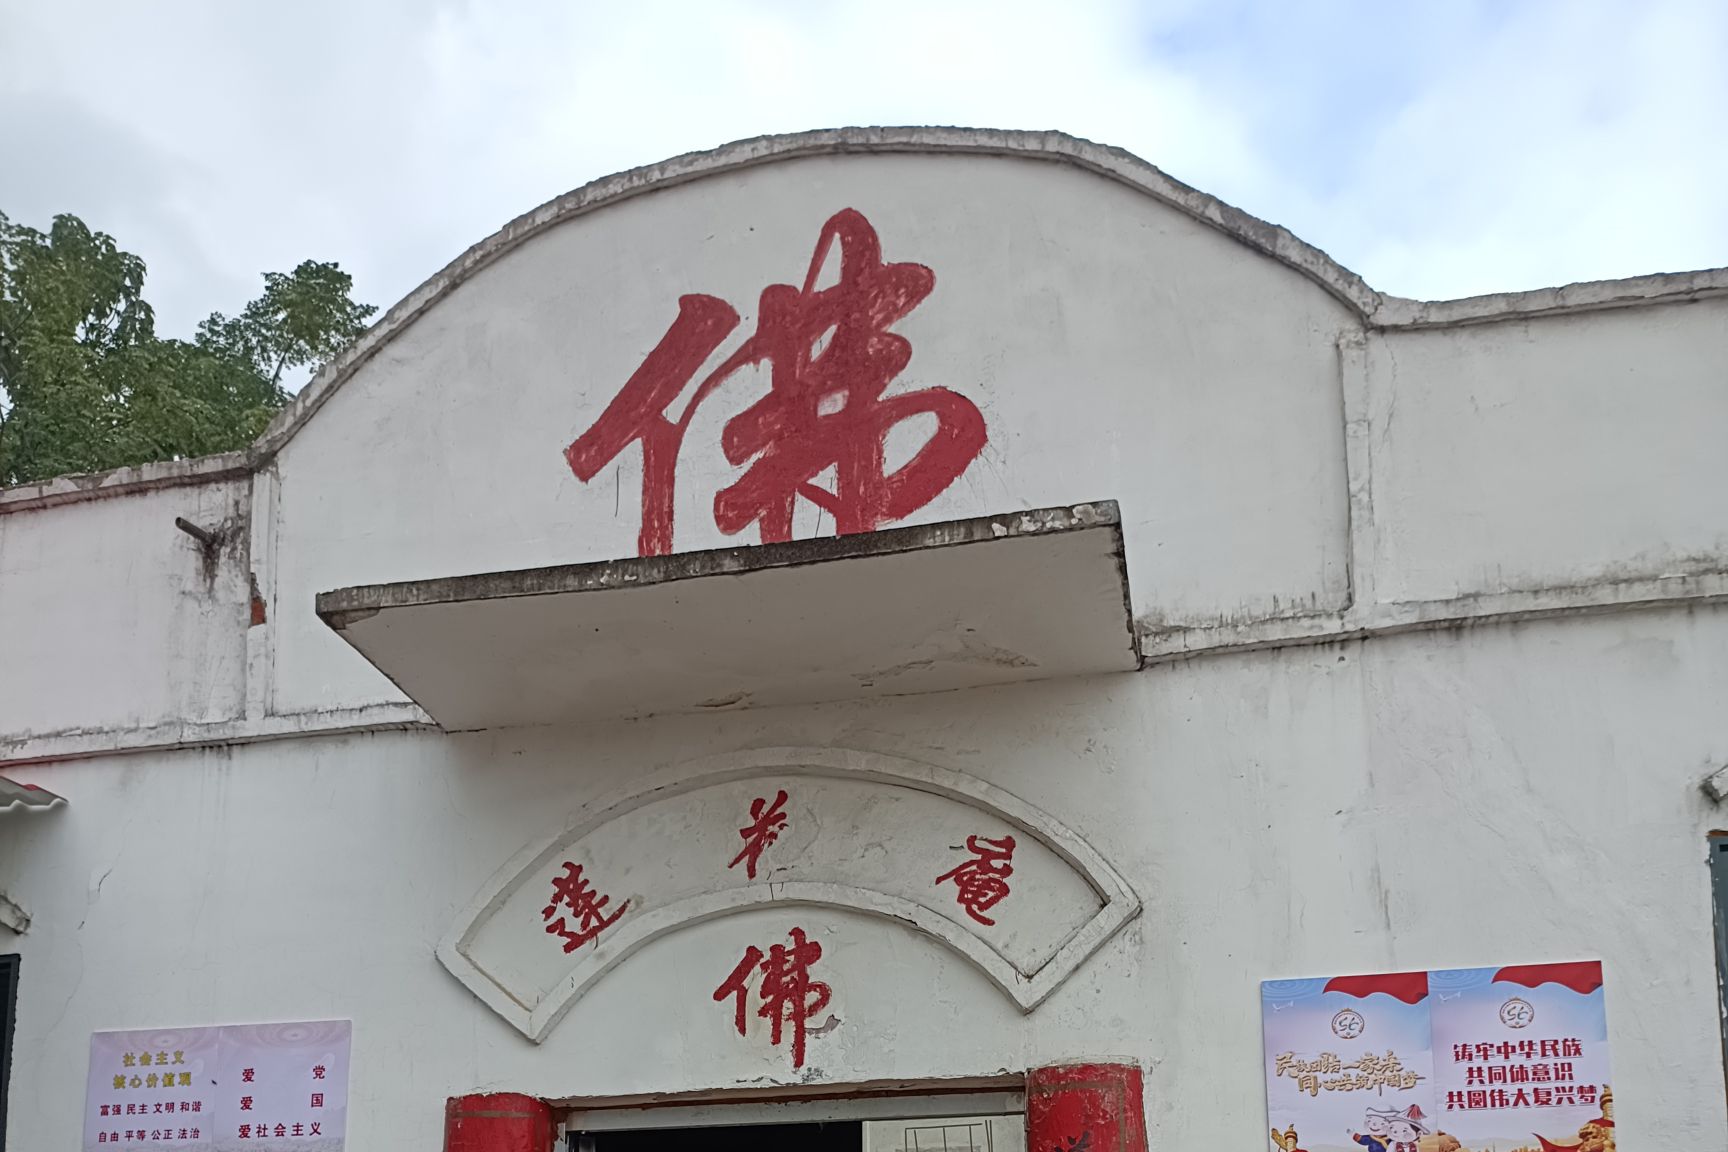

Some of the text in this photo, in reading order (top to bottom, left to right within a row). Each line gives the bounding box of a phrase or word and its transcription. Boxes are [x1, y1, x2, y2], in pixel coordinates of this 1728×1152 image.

[122, 1051, 185, 1067] 社会主义
[1453, 1038, 1583, 1063] 铸牢中华民族
[1275, 1050, 1404, 1078] 民族团结一家亲
[1465, 1062, 1575, 1086] 共同体意识
[113, 1072, 192, 1089] 核心价值观
[1297, 1072, 1426, 1096] 同心共筑中国梦
[1446, 1085, 1598, 1111] 共圆伟大复兴梦
[238, 1122, 322, 1139] 爱社会主义
